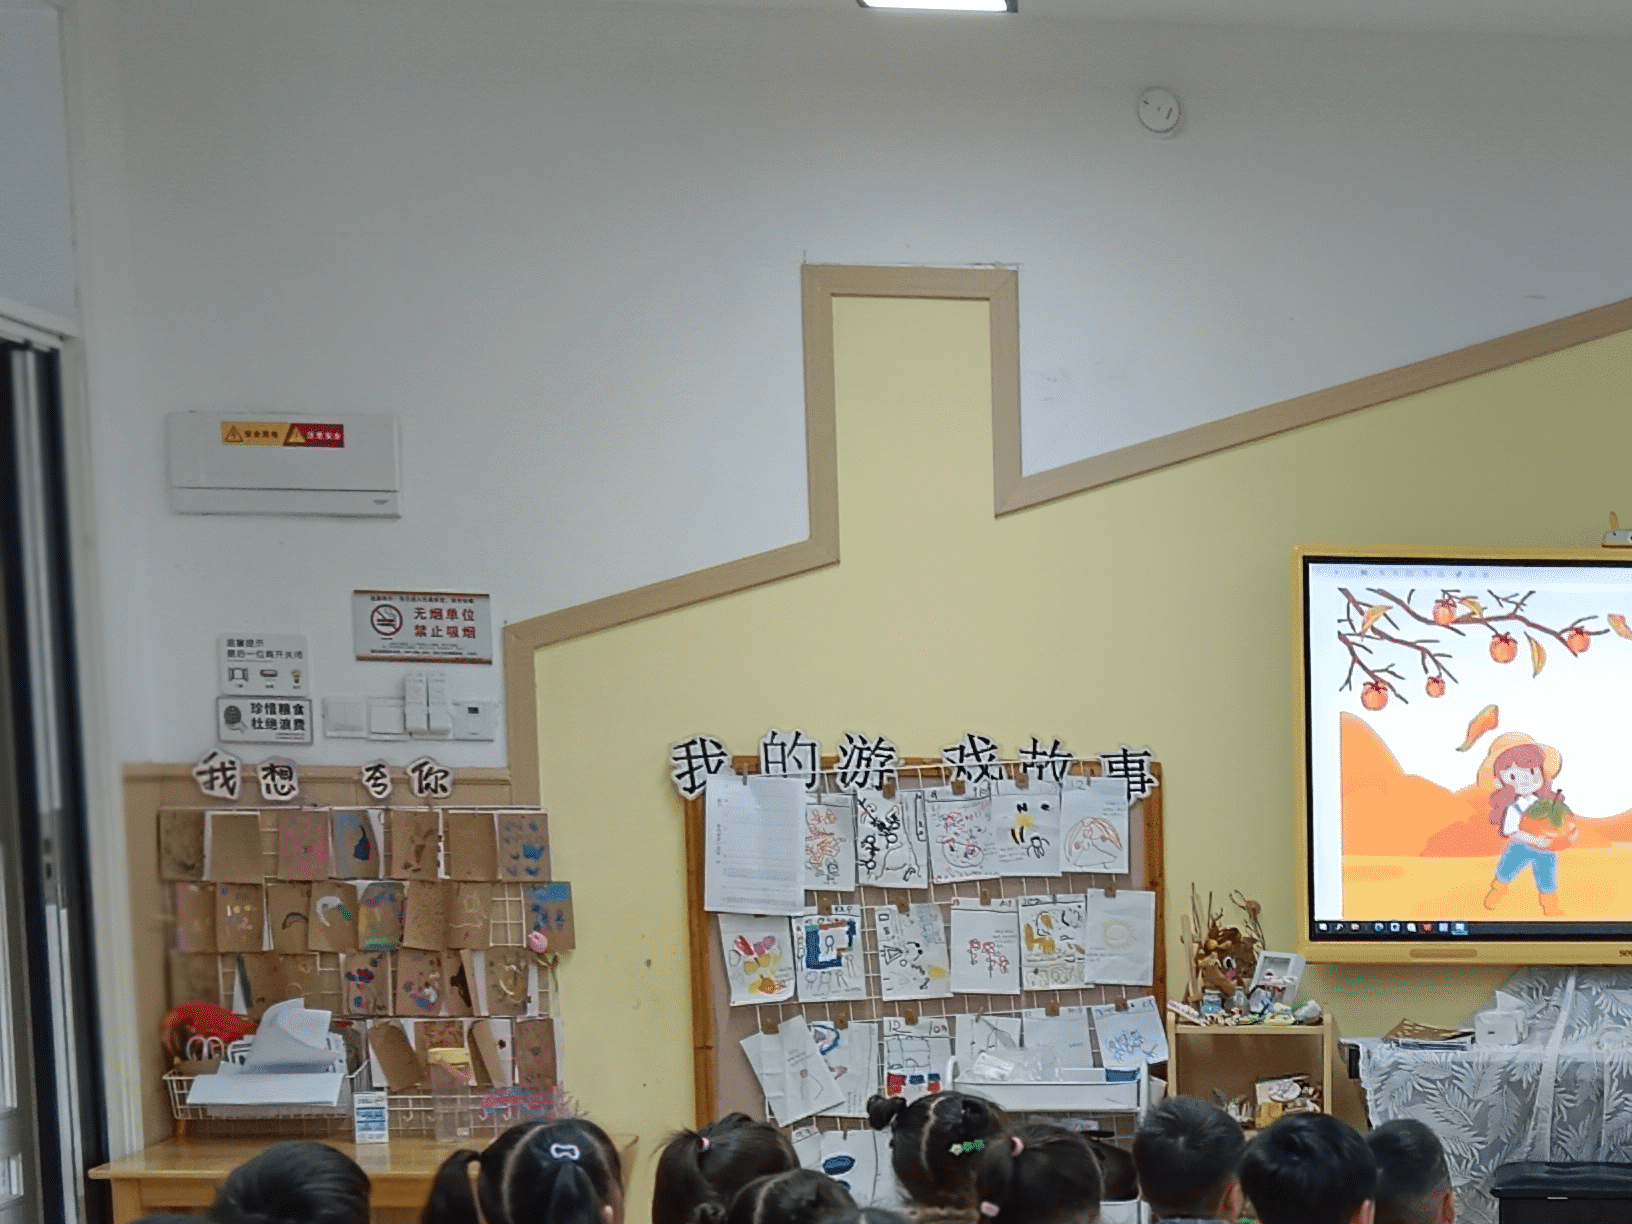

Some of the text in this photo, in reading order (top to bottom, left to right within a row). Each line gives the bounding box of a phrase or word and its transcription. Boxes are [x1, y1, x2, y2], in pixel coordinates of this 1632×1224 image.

[414, 607, 475, 621] 无烟单位
[414, 624, 476, 639] 禁止吸烟
[250, 702, 304, 715] 珍惜粮食
[251, 717, 305, 731] 杜绝浪费
[672, 731, 1155, 799] 我的游戏故事
